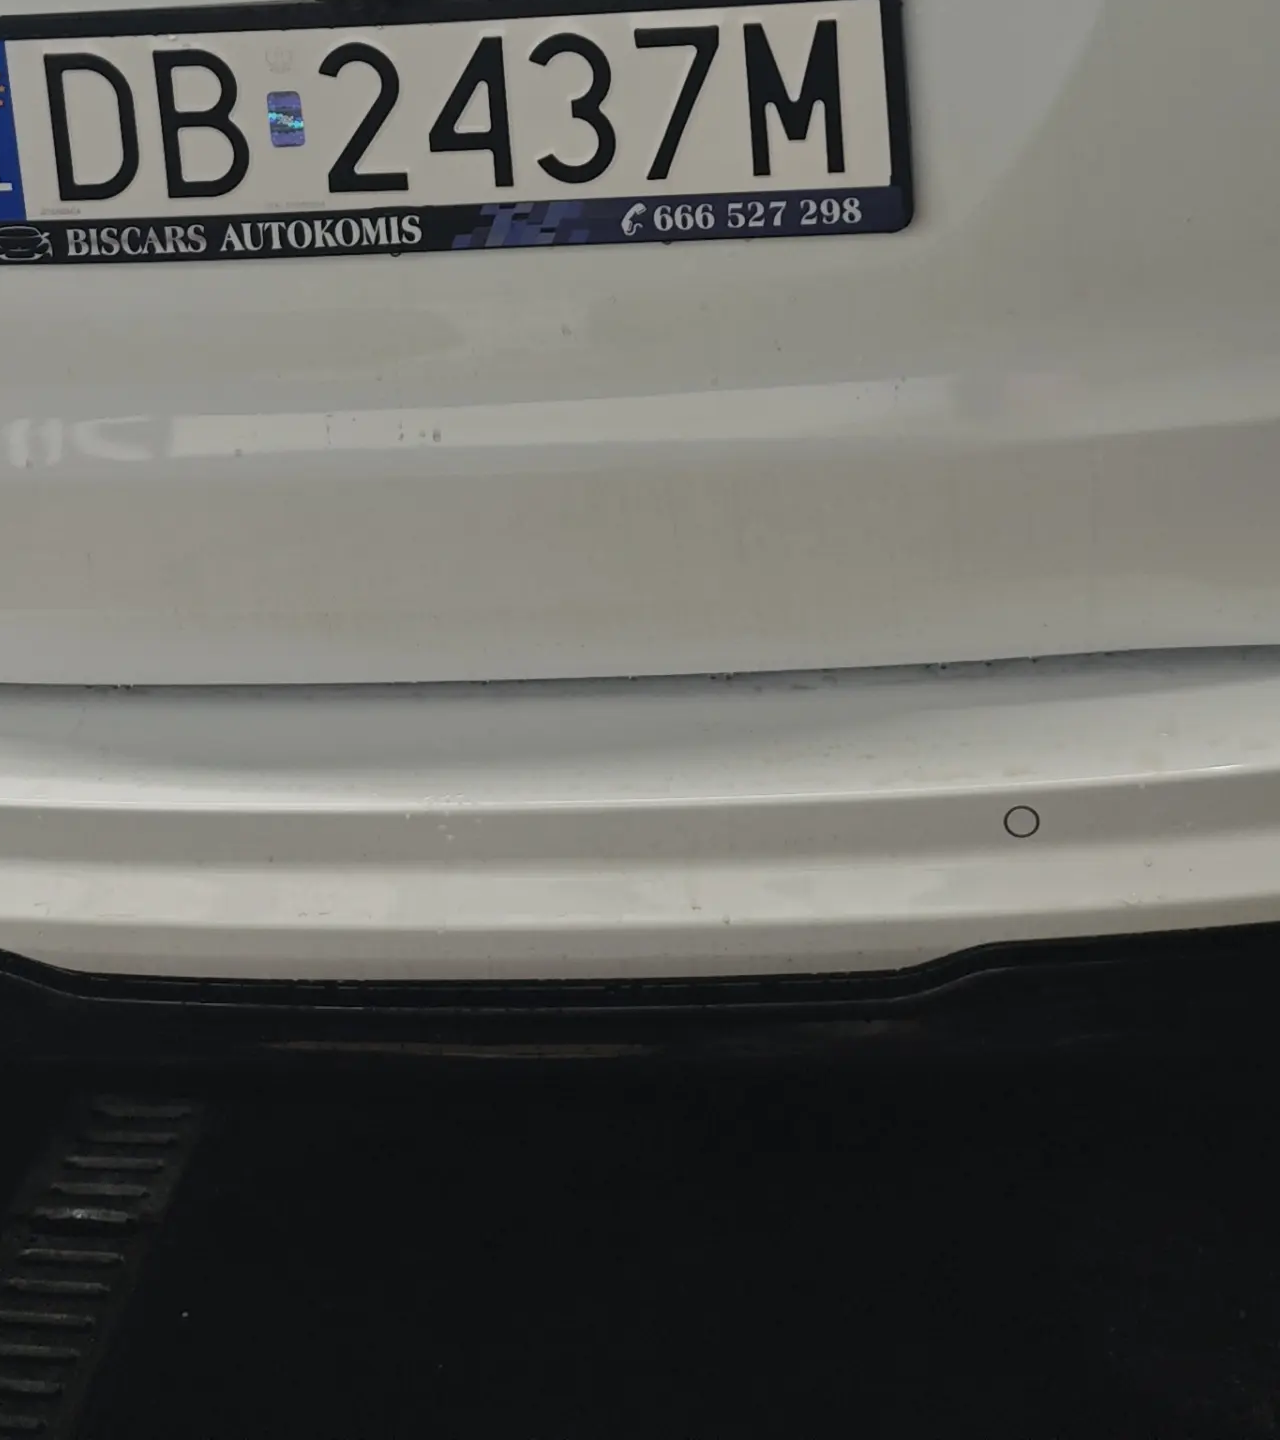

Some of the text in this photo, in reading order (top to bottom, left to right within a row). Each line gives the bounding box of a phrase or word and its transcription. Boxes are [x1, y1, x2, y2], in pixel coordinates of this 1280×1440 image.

[43, 19, 846, 200] DB 2437M
[653, 197, 863, 232] 666 527 298
[66, 215, 423, 256] BISCARS AUTOKOMIS
